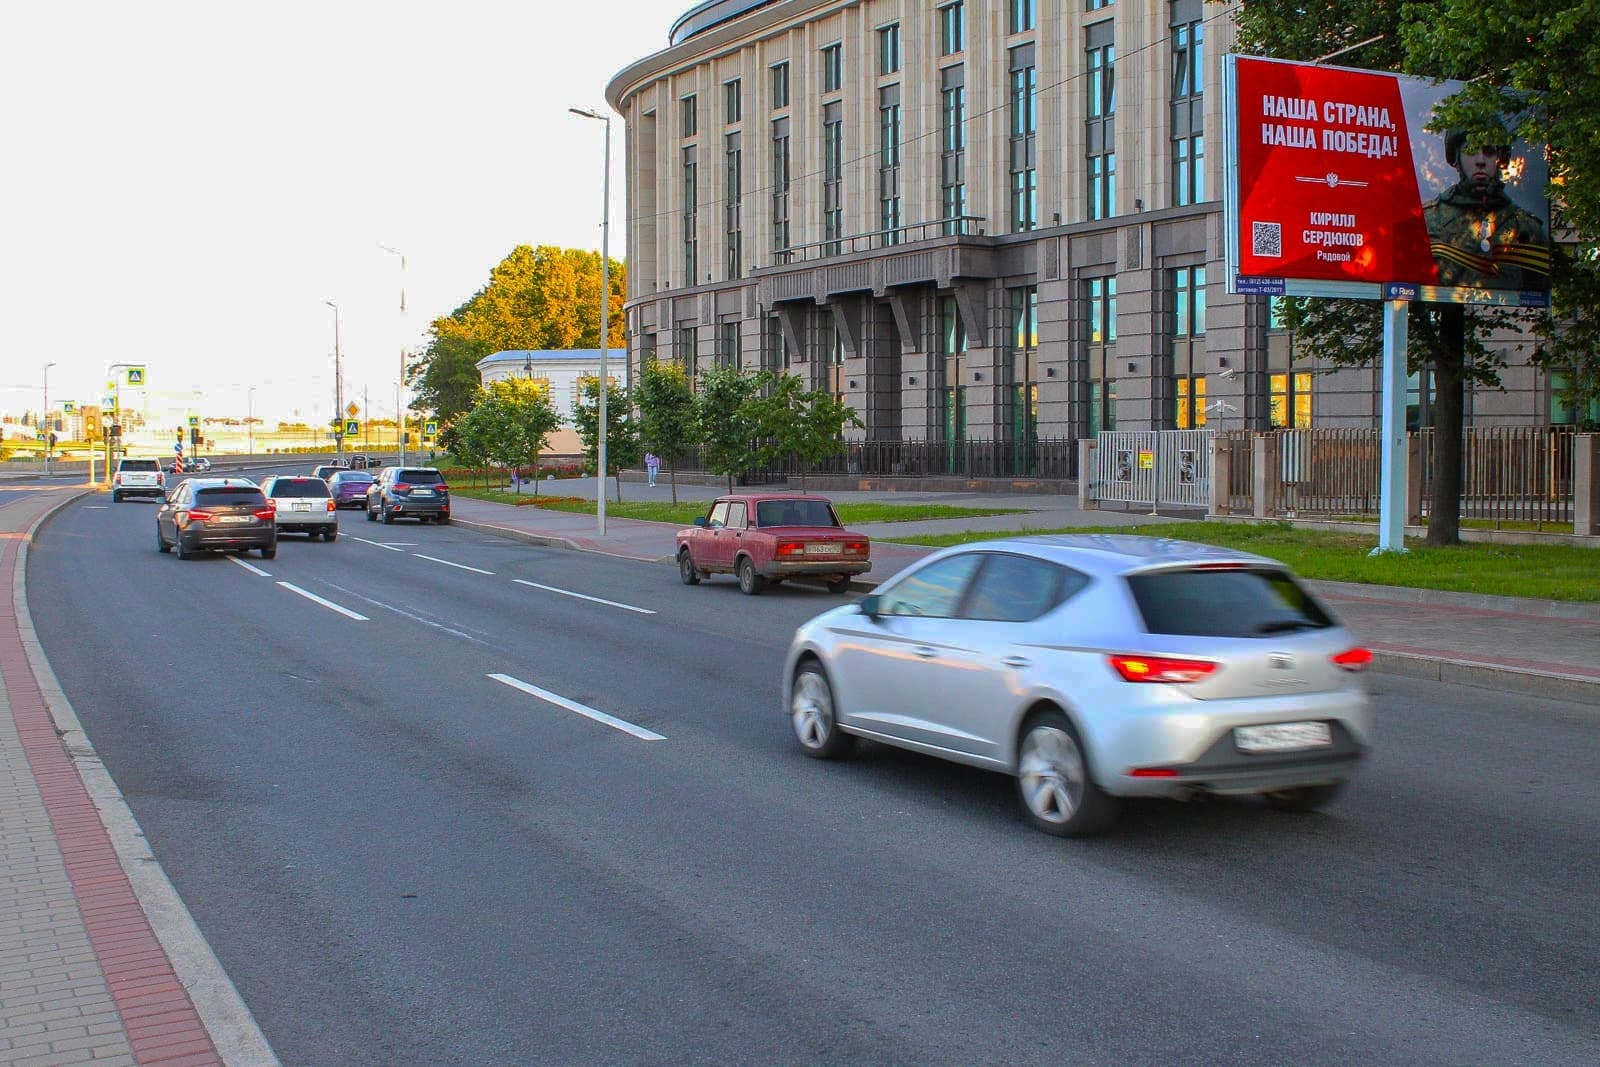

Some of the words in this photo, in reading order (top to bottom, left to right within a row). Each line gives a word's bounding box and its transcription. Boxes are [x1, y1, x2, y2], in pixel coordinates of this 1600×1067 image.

[1262, 94, 1318, 121] НАША
[1323, 101, 1396, 133] СТРАНА,
[1261, 123, 1317, 149] НАША
[1322, 129, 1398, 159] ПОБЕДА!
[1310, 211, 1356, 228] КИРИЛЛ
[1302, 230, 1364, 247] СЕРДЮКОВ
[1316, 250, 1351, 262] Рядовой
